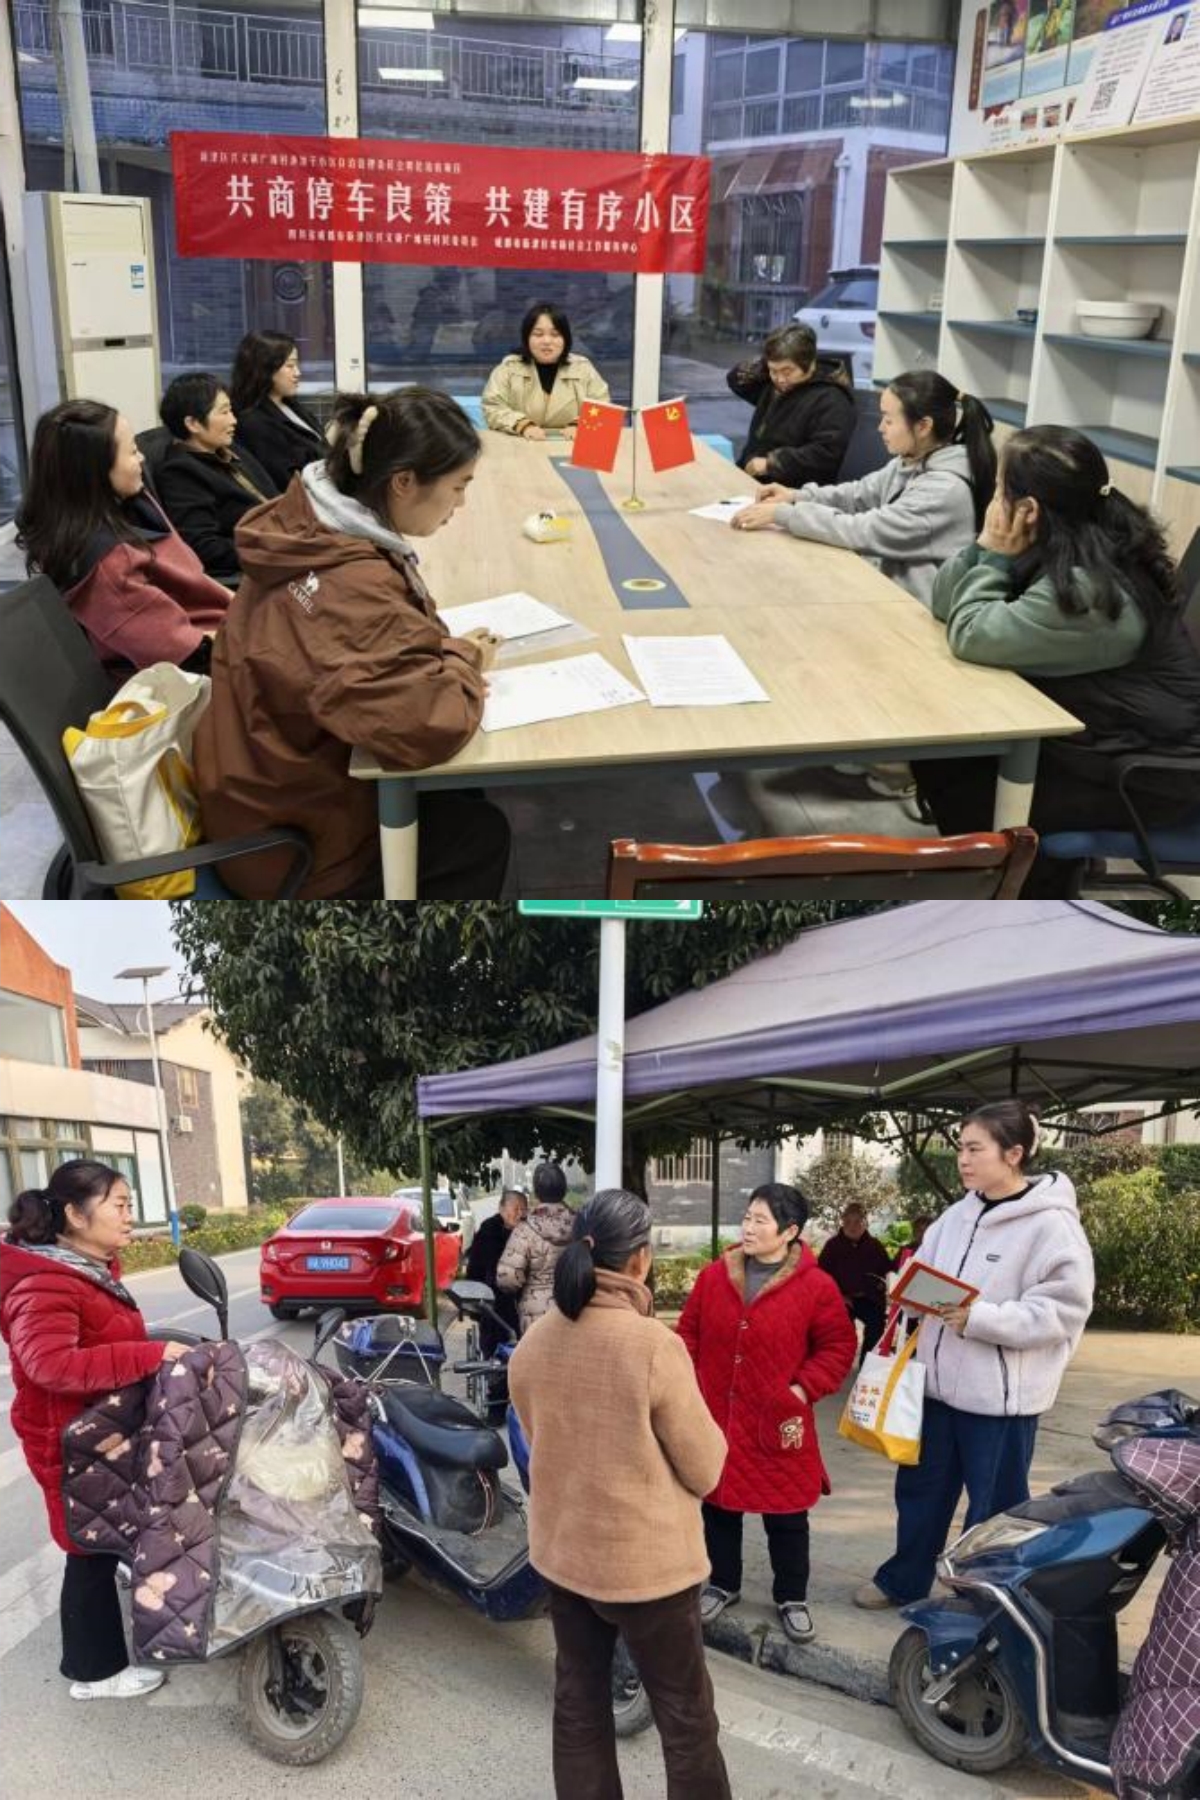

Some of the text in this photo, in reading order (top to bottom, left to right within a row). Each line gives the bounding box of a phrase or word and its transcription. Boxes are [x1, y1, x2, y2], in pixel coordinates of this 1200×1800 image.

[226, 174, 696, 233] 共商停车良策 共建有序小区
